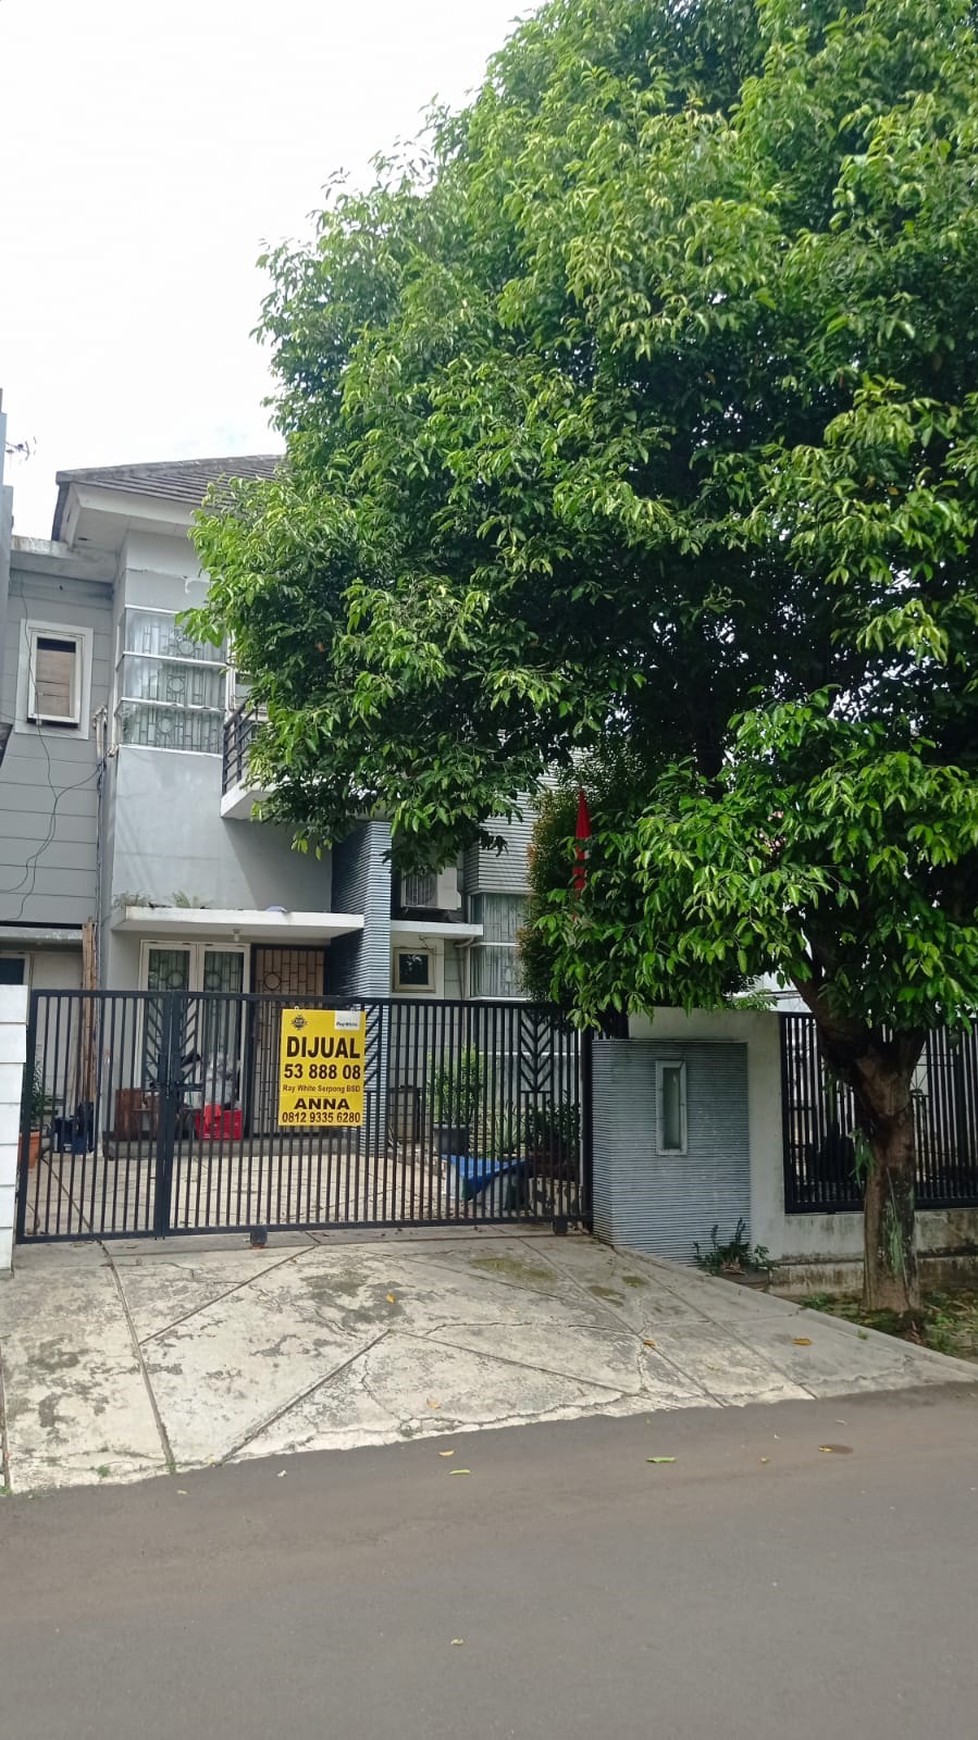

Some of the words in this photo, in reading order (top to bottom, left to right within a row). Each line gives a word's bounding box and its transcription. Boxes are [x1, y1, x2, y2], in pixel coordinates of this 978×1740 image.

[286, 1036, 360, 1058] DIJUAL
[284, 1063, 303, 1079] 53
[309, 1064, 337, 1079] 888
[342, 1064, 361, 1080] 08
[282, 1085, 296, 1094] Ray
[297, 1084, 316, 1093] White
[317, 1084, 345, 1094] Serpong
[346, 1085, 361, 1093] BSD
[293, 1098, 350, 1110] ANNA
[282, 1111, 307, 1123] 0812
[309, 1112, 334, 1123] 9335
[336, 1112, 361, 1123] 6280
